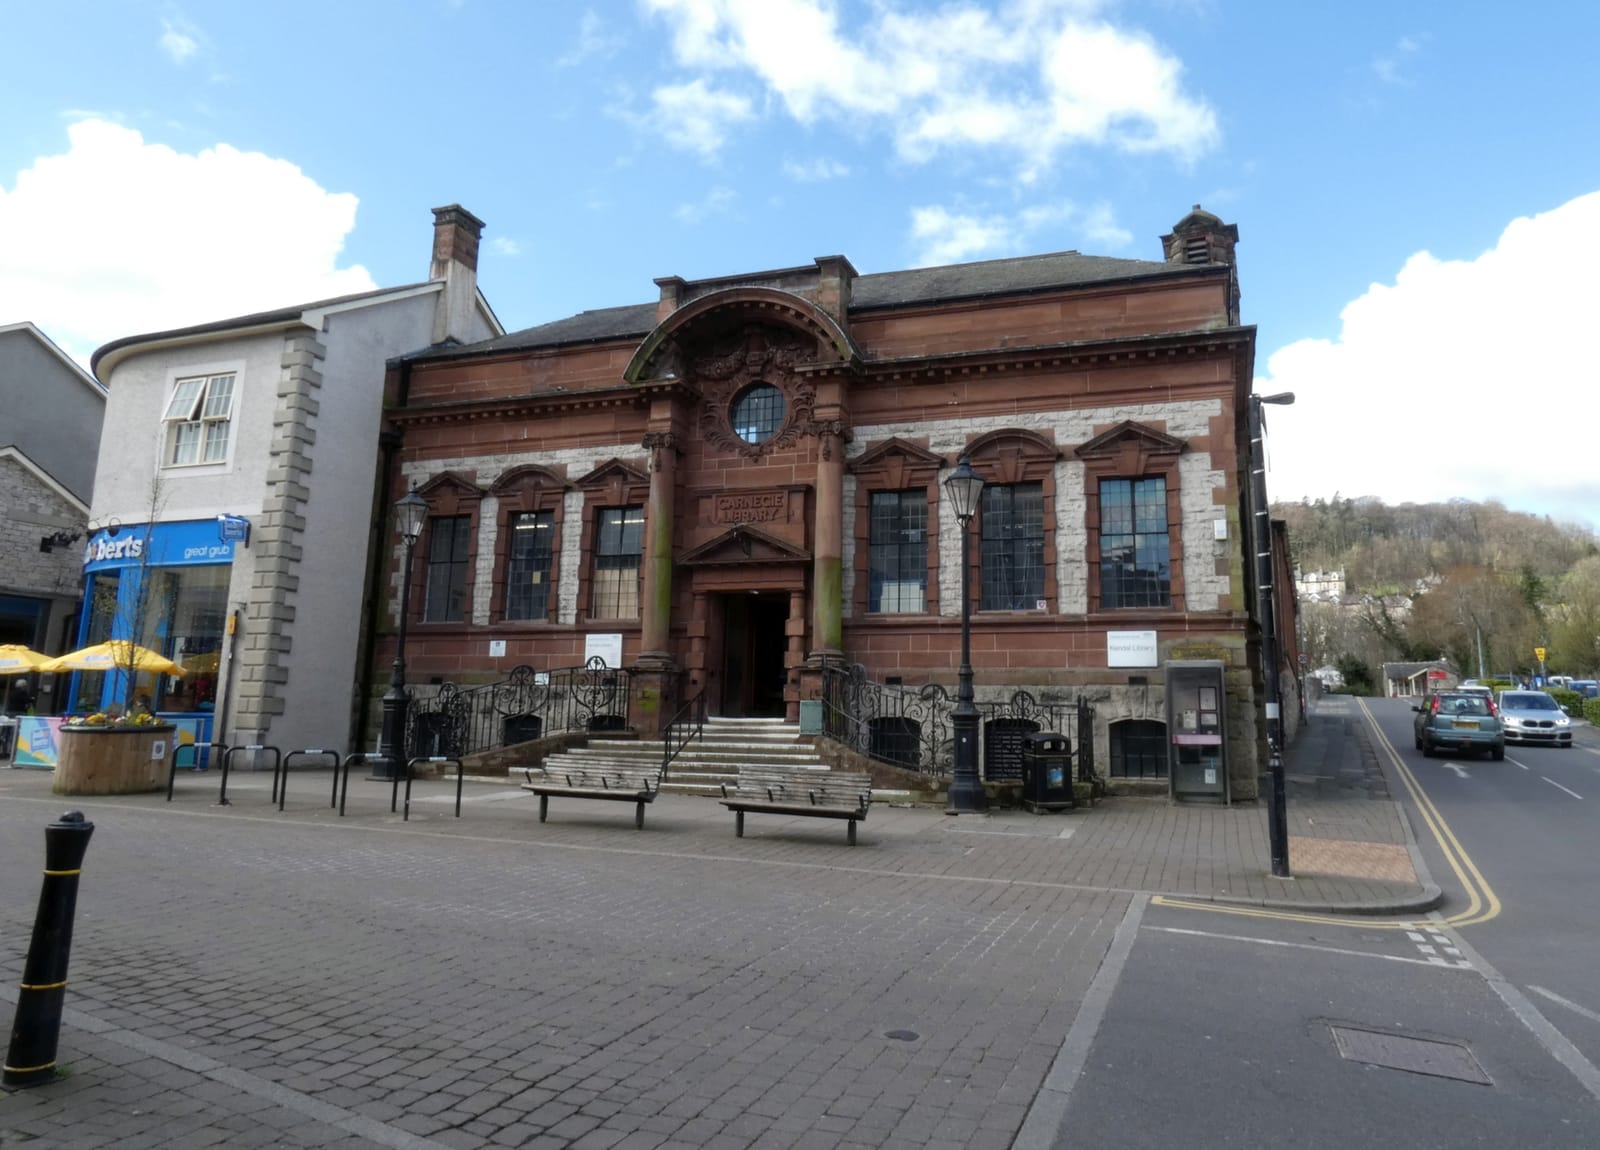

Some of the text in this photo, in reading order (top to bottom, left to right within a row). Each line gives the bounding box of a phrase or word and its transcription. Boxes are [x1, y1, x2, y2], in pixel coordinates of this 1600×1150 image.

[720, 495, 783, 510] CARNEGIE
[724, 509, 778, 523] LIBRARY
[184, 544, 230, 559] great grub
